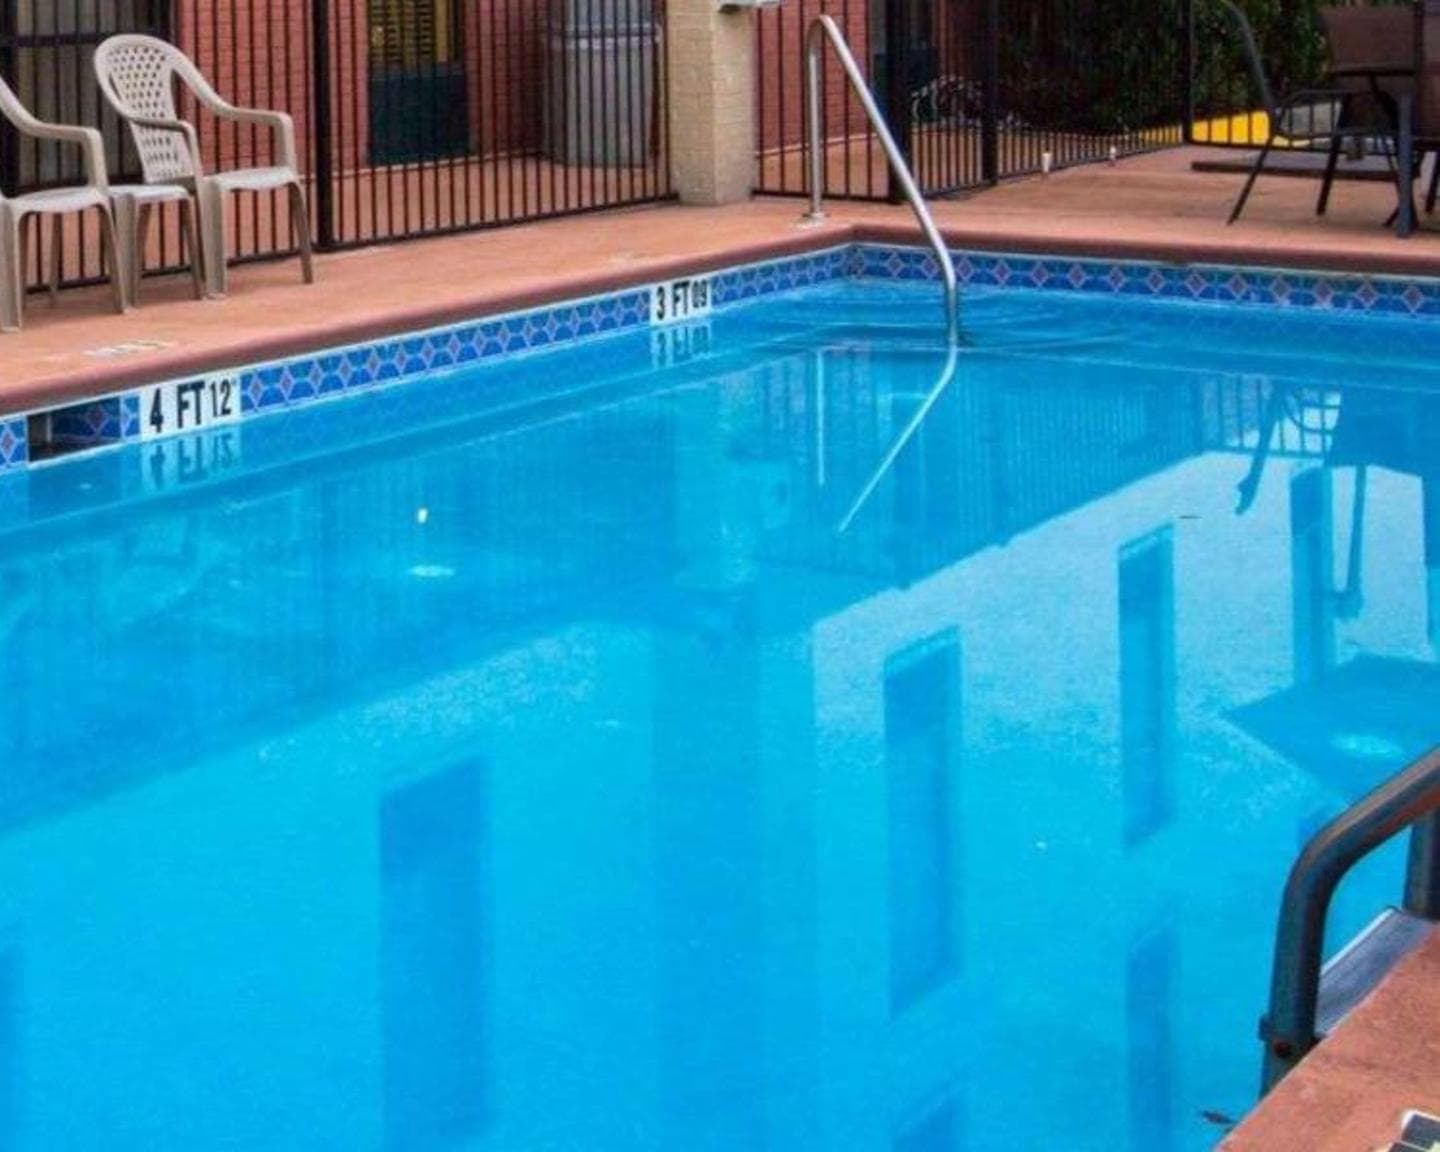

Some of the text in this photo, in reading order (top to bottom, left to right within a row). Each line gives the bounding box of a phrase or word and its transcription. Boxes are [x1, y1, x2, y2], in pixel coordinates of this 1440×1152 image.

[657, 285, 665, 320] 3
[672, 280, 690, 317] FT
[150, 388, 163, 433] 4
[177, 381, 206, 428] FT
